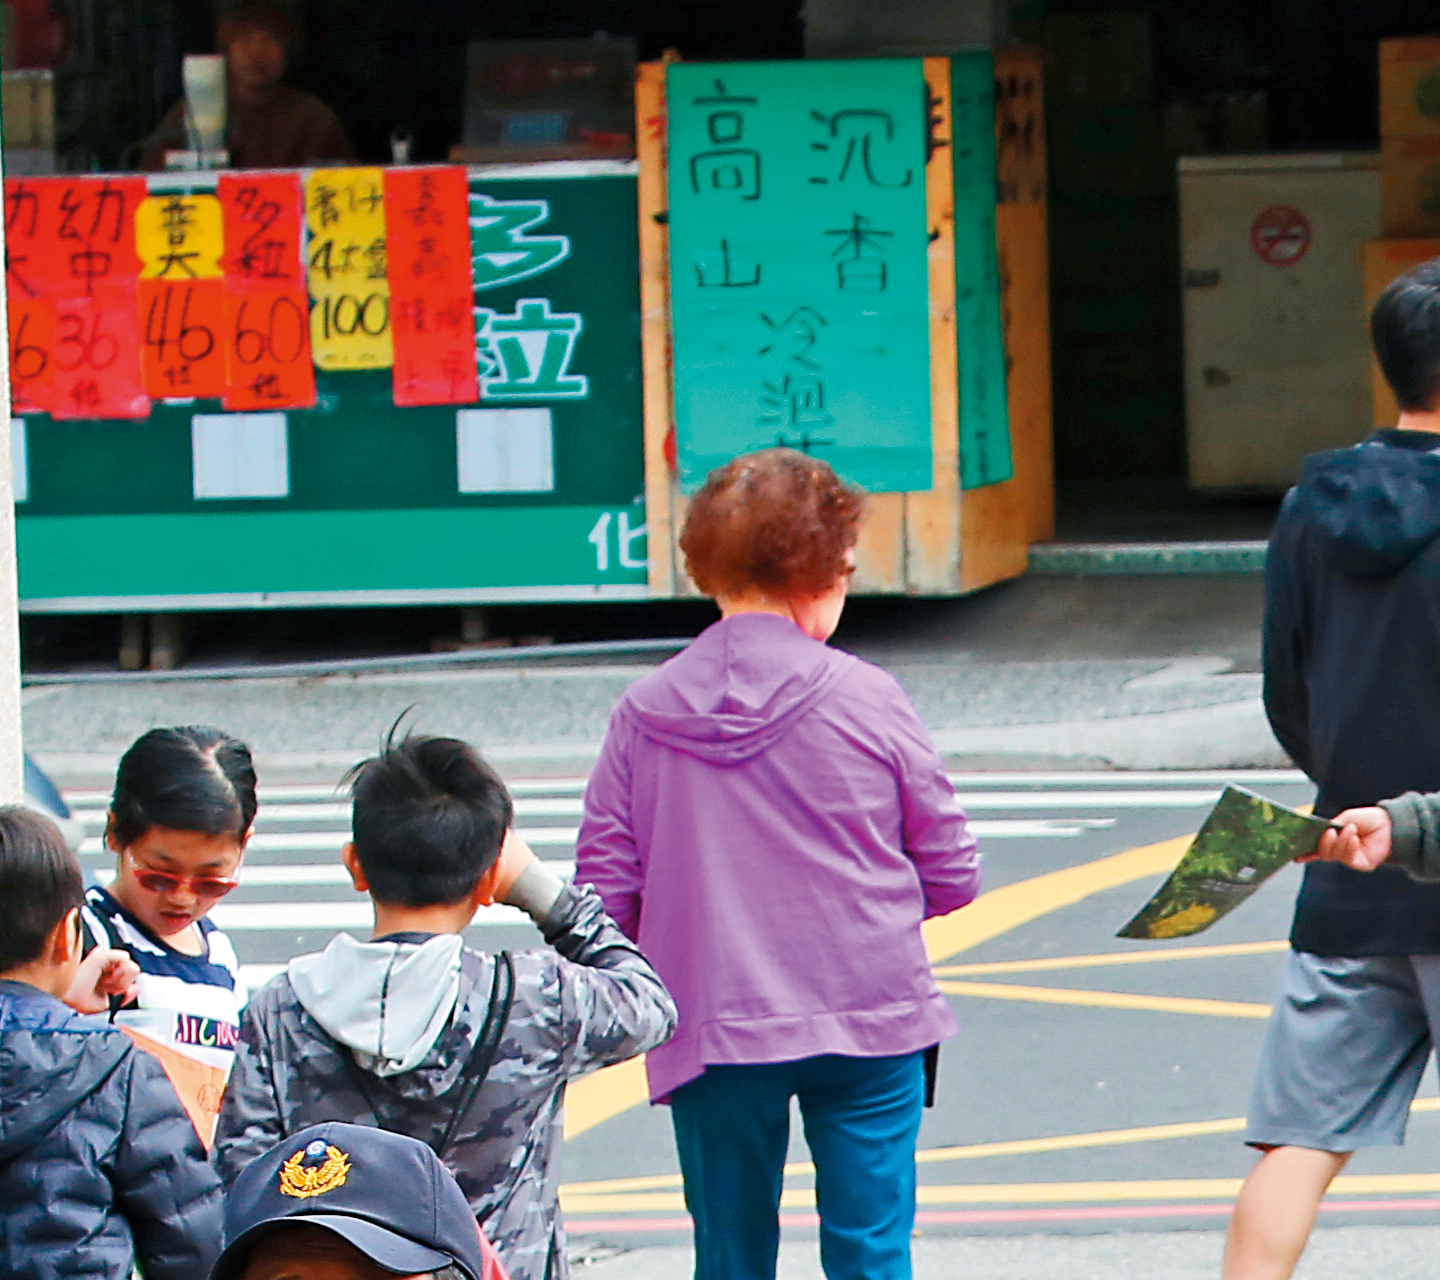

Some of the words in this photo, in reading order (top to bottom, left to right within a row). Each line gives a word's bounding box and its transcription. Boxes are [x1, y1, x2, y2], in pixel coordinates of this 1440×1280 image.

[690, 78, 761, 288] 高山
[807, 108, 912, 292] 沉香
[58, 179, 125, 296] 幼中
[13, 312, 48, 380] 6
[57, 313, 117, 371] 36
[145, 286, 215, 362] 46
[234, 297, 304, 365] 60
[322, 294, 388, 341] 100
